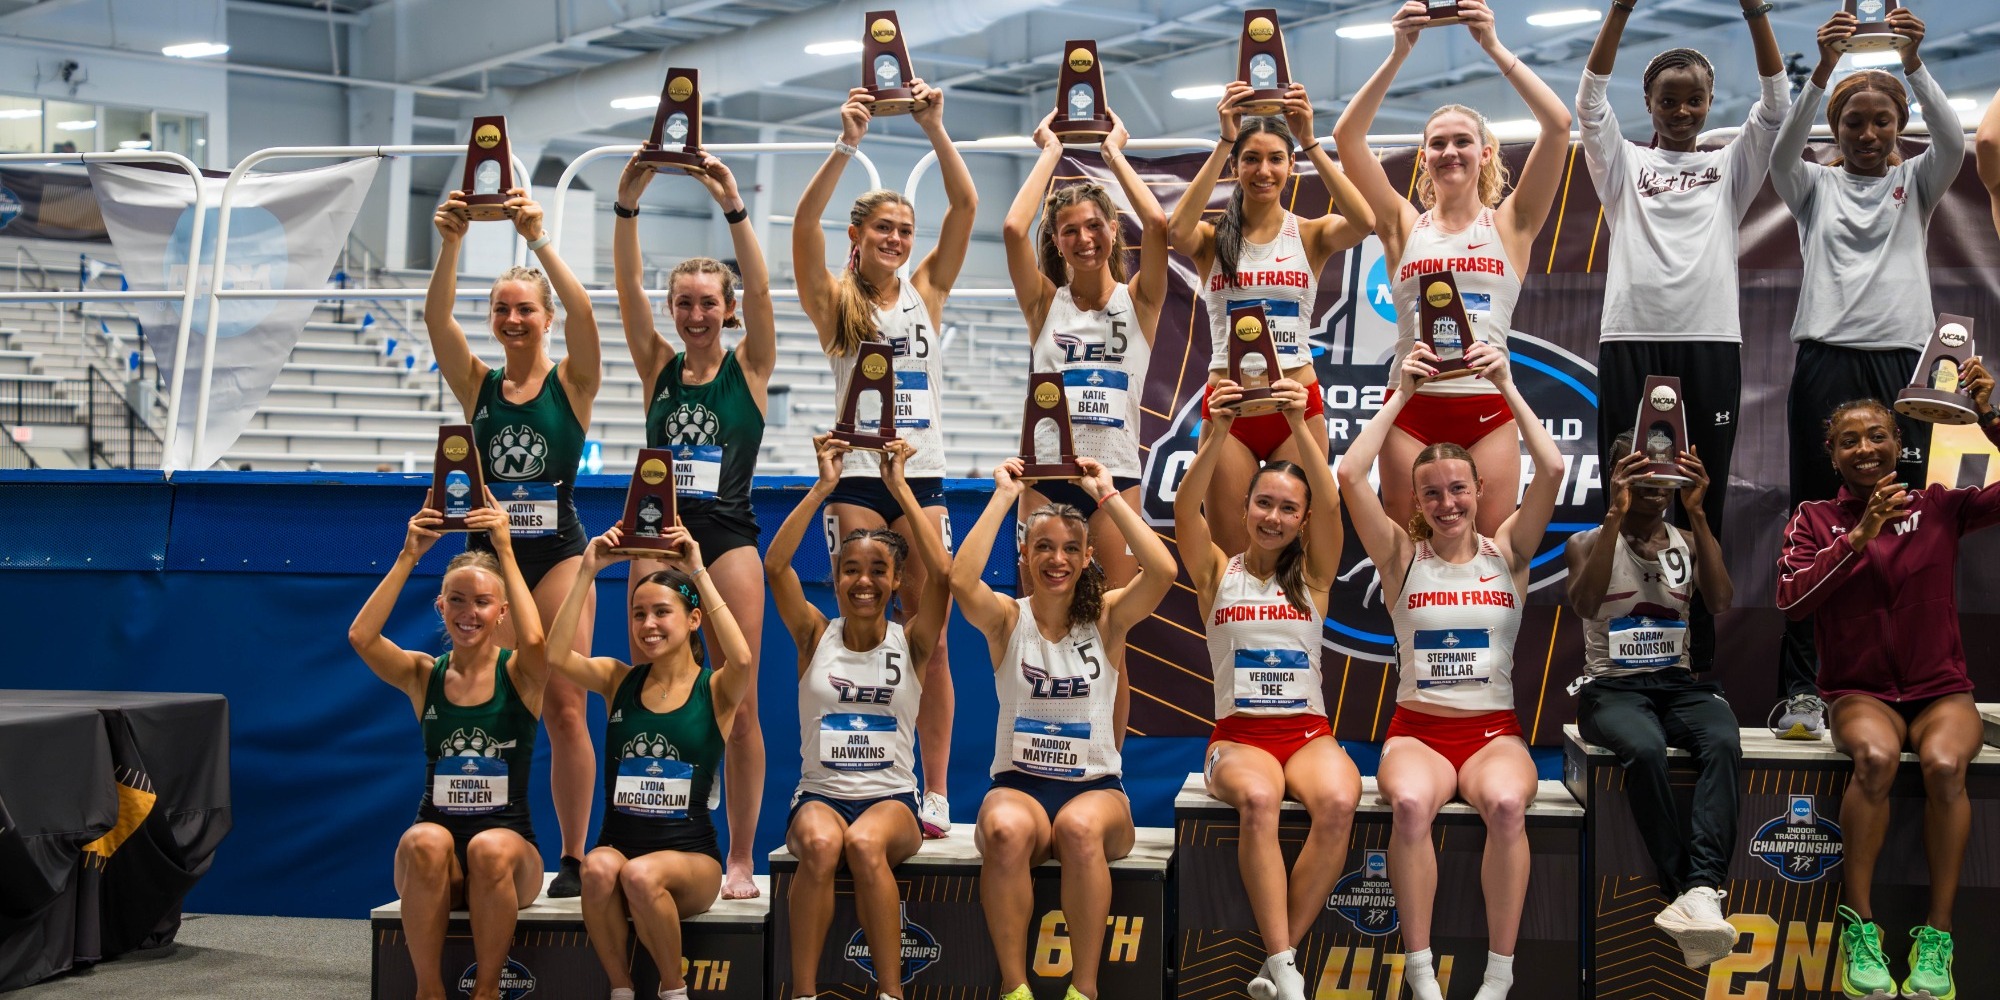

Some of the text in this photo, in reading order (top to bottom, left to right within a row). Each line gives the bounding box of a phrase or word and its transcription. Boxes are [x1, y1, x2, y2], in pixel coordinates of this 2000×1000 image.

[1400, 257, 1505, 283] SIMON FRASER
[1256, 270, 1309, 290] FRASER
[915, 324, 929, 359] 5
[1111, 321, 1128, 354] 5
[1273, 330, 1296, 343] VICH
[1940, 331, 1967, 343] NCAA
[863, 364, 886, 375] NCAA
[893, 393, 912, 403] LEN
[1036, 393, 1059, 403] NCAA
[1082, 389, 1107, 401] KATIE
[1318, 384, 1387, 411] 02
[1652, 397, 1676, 405] NCAA
[894, 404, 913, 416] EN
[1078, 401, 1110, 415] BEAM
[445, 447, 467, 456] NCAA
[501, 453, 528, 474] N
[675, 463, 692, 473] KIKI
[674, 474, 696, 487] VITT
[506, 503, 535, 514] JADYN
[508, 515, 543, 527] ARNES
[1893, 510, 1922, 537] WT
[826, 517, 836, 553] 5
[1665, 547, 1686, 585] 9
[1408, 590, 1515, 610] SIMON FRASER
[1214, 603, 1313, 626] SIMON FRASER
[1632, 631, 1664, 642] SARAH
[1619, 641, 1675, 656] KOOMSON
[1077, 642, 1101, 681] 5
[1427, 651, 1477, 663] STEPHANIE
[885, 652, 901, 686] 5
[1431, 664, 1474, 677] MILLAR
[1249, 671, 1295, 683] VERONICA
[1030, 675, 1091, 700] LEE
[1261, 684, 1284, 696] DEE
[838, 685, 895, 707] LEE
[847, 734, 870, 745] ARIA
[1031, 737, 1071, 751] MADDOX
[831, 746, 885, 759] HAWKINS
[1022, 748, 1078, 766] MAYFIELD
[450, 779, 491, 790] KENDALL
[640, 781, 665, 792] LYDIA
[447, 791, 492, 804] TIETJEN
[617, 791, 687, 807] MCGLOCKLIN
[1786, 826, 1816, 834] INDOOR
[1752, 840, 1843, 855] CHAMPIONSHIP
[1362, 880, 1390, 888] INDOOR
[1330, 894, 1396, 908] CHAMPIONS
[1032, 909, 1145, 978] 6H
[848, 945, 938, 959] CHANSHIPS
[1703, 913, 1886, 1000] 2N
[680, 956, 732, 992] TH
[461, 978, 533, 989] CHNSHIPS
